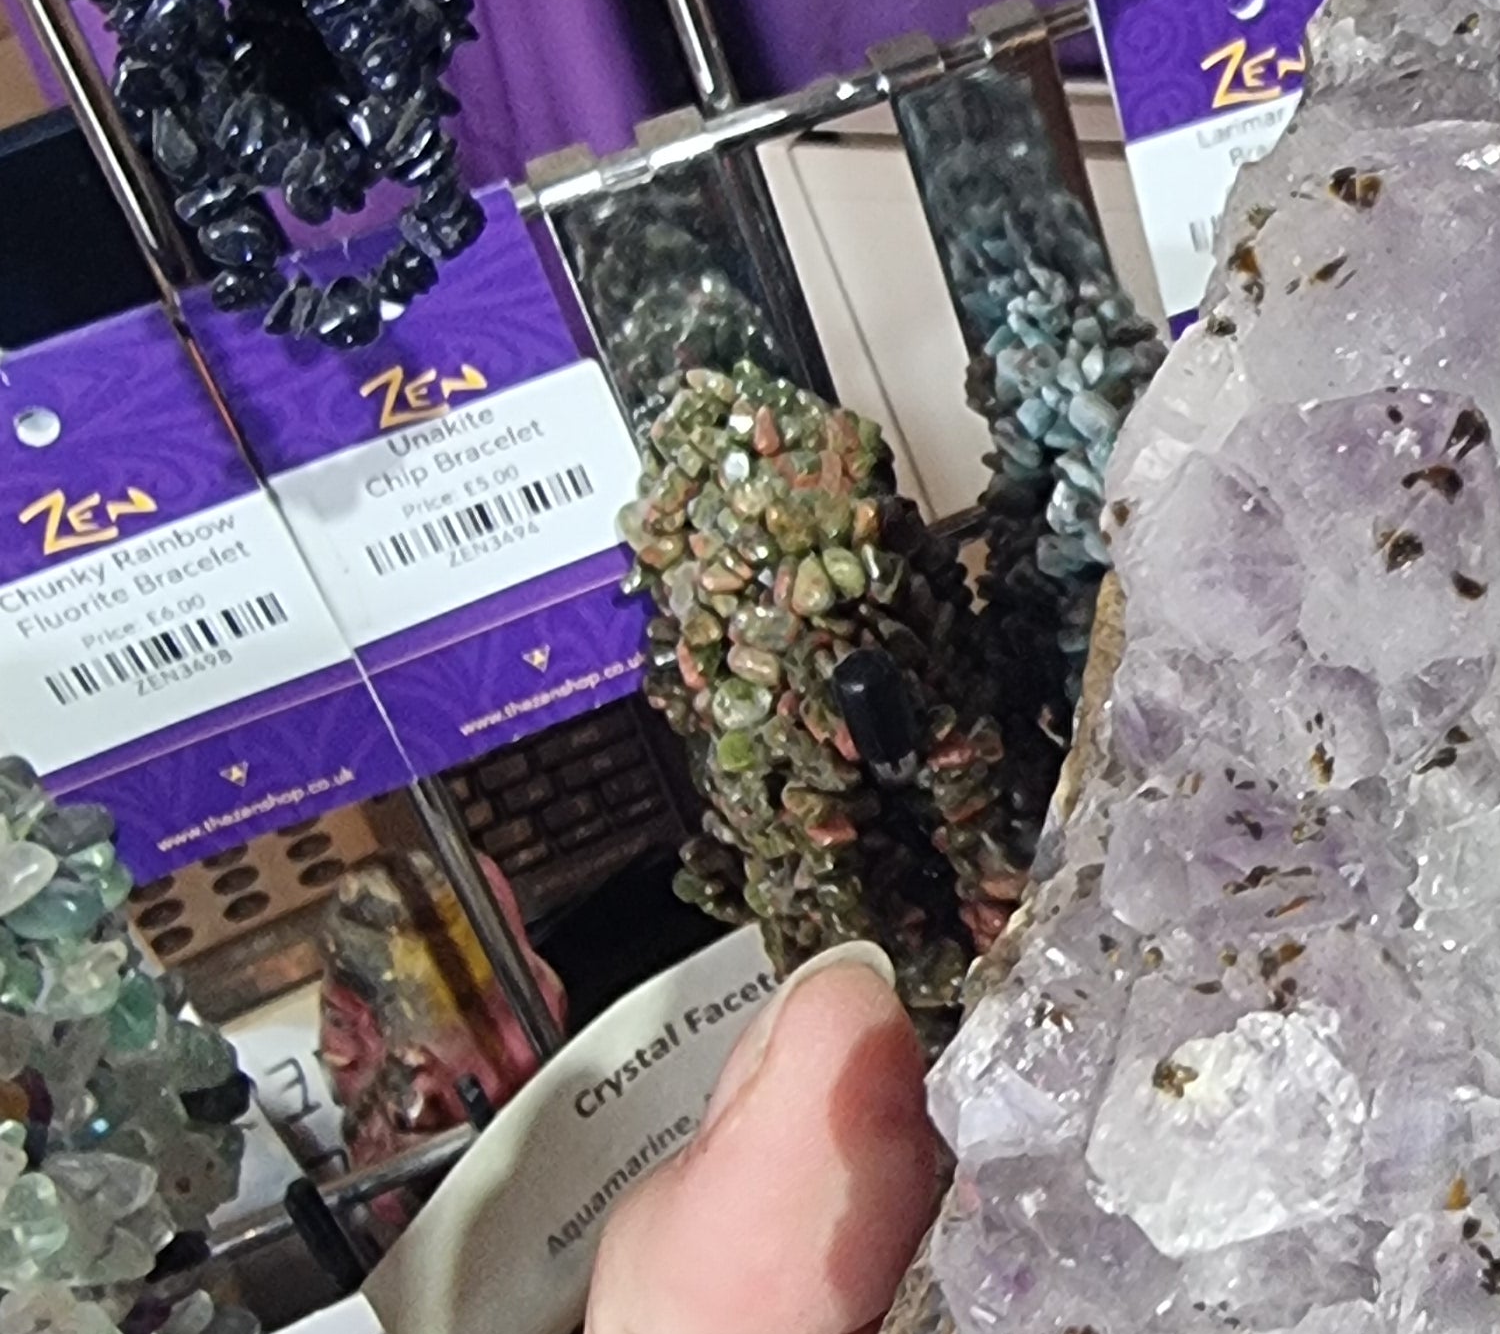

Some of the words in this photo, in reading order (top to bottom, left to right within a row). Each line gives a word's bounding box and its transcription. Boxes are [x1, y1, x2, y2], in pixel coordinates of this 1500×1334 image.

[1201, 38, 1306, 109] ZEN
[1196, 104, 1287, 149] Larimar
[359, 364, 487, 429] ZEN
[365, 466, 429, 499] Chip
[434, 419, 545, 472] Bracelet
[387, 407, 495, 458] Unakite
[463, 464, 520, 498] £5.00
[19, 487, 157, 555] ZEN
[448, 520, 540, 569] ZEN3494
[0, 562, 105, 613] Chunky
[111, 515, 235, 570] Rainbow
[16, 588, 129, 639] Fluorite
[133, 540, 250, 595] Bracelet
[147, 593, 206, 627] £6.00
[136, 649, 233, 697] ZEN3498
[574, 1022, 681, 1118] Crystal
[683, 971, 777, 1035] Facet
[546, 1115, 701, 1257] Aquamarine,
